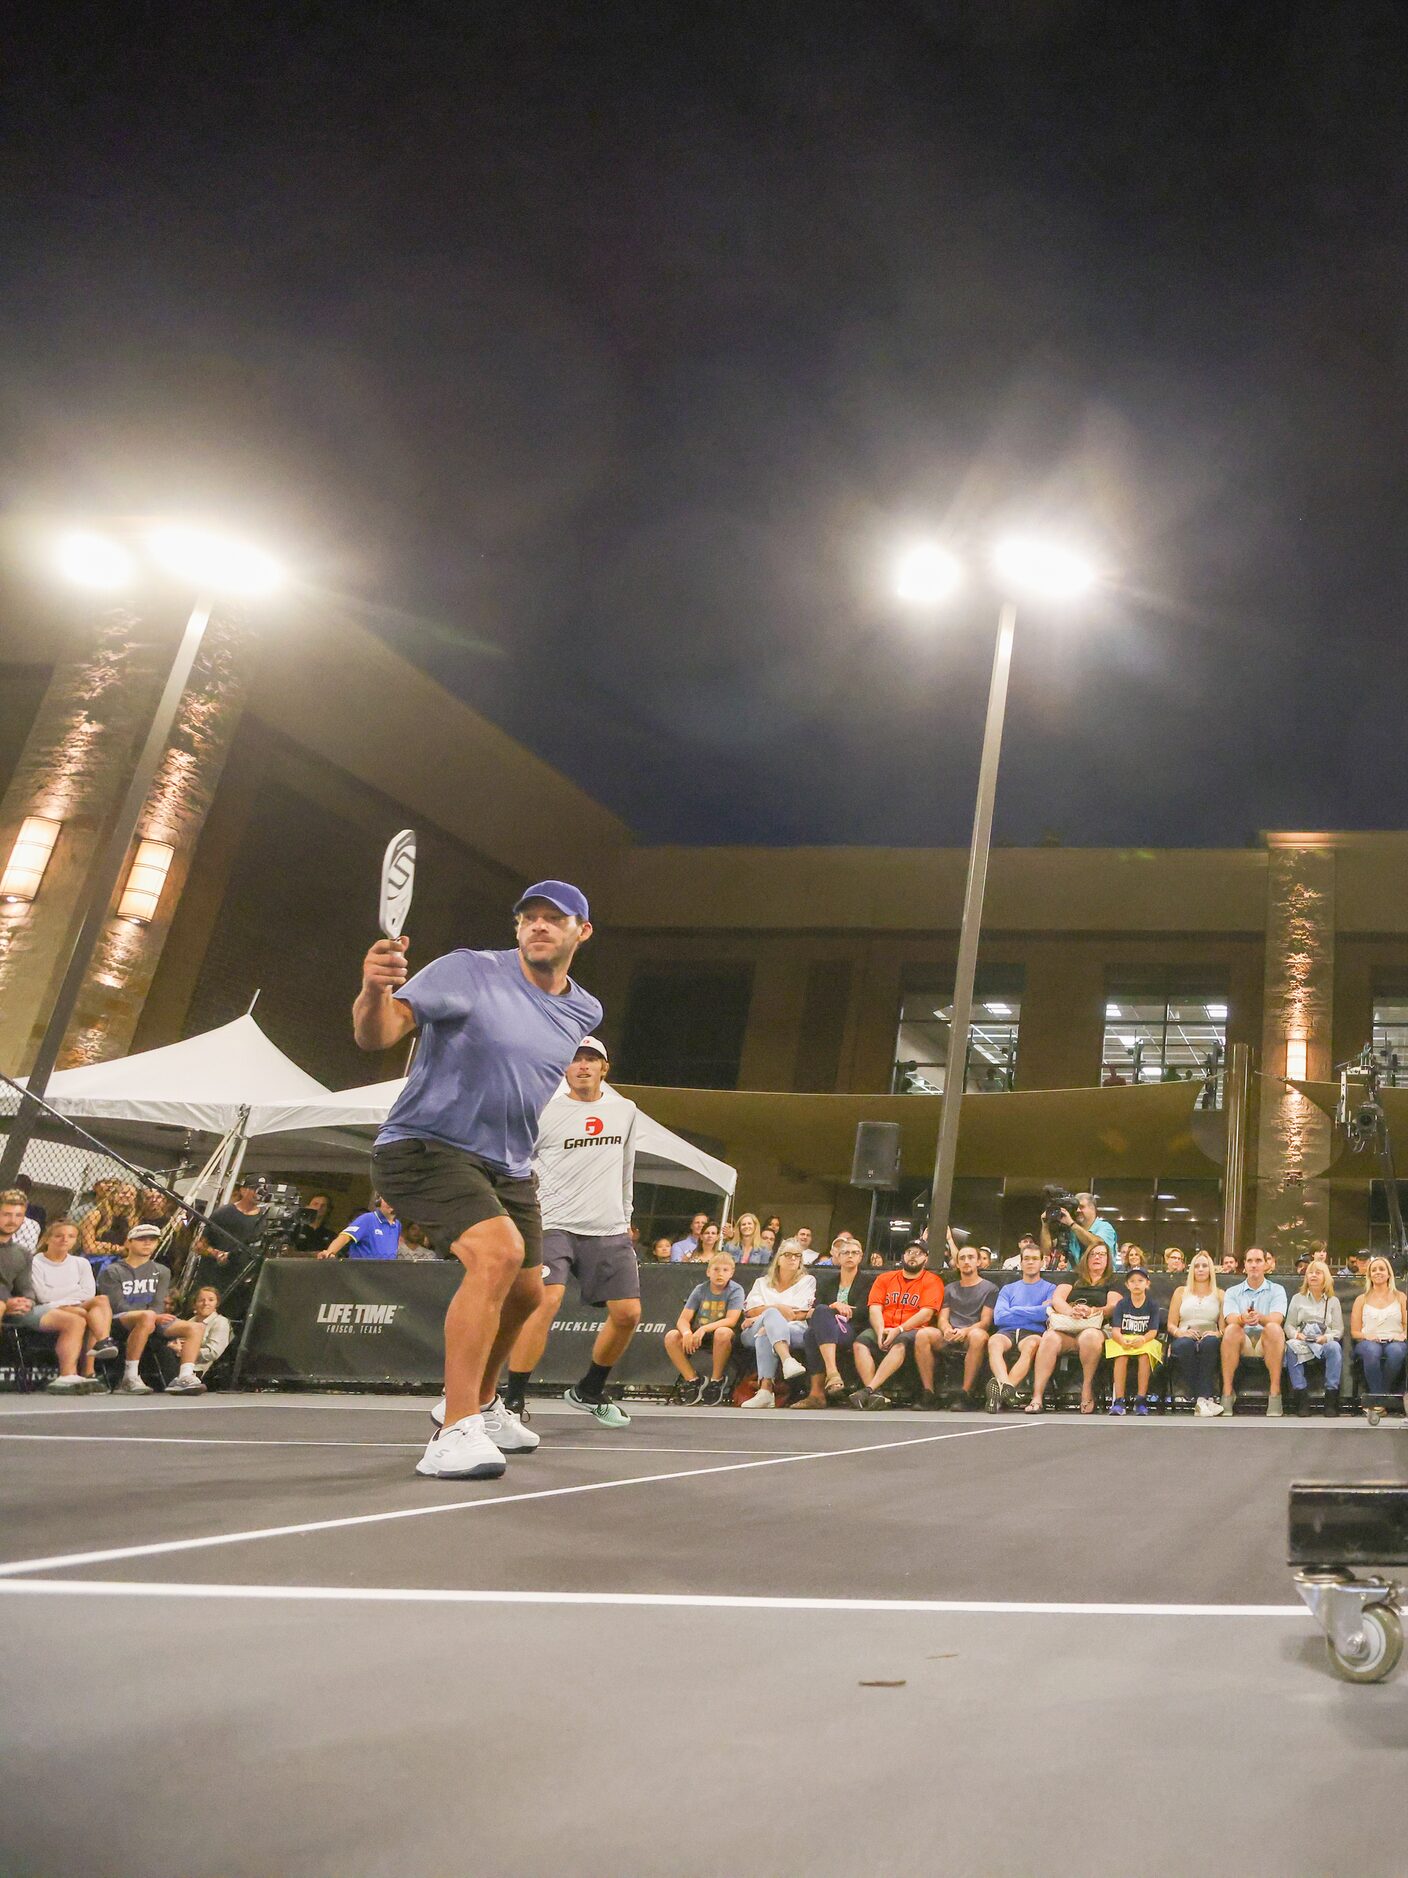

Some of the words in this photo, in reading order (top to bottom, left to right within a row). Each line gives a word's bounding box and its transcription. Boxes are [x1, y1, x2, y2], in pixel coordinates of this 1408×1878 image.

[563, 1135, 622, 1150] GAMMA
[317, 1303, 354, 1323] LIFE
[354, 1304, 397, 1324] TIME
[326, 1325, 355, 1334] FRISCO,
[360, 1325, 382, 1334] TEXAS
